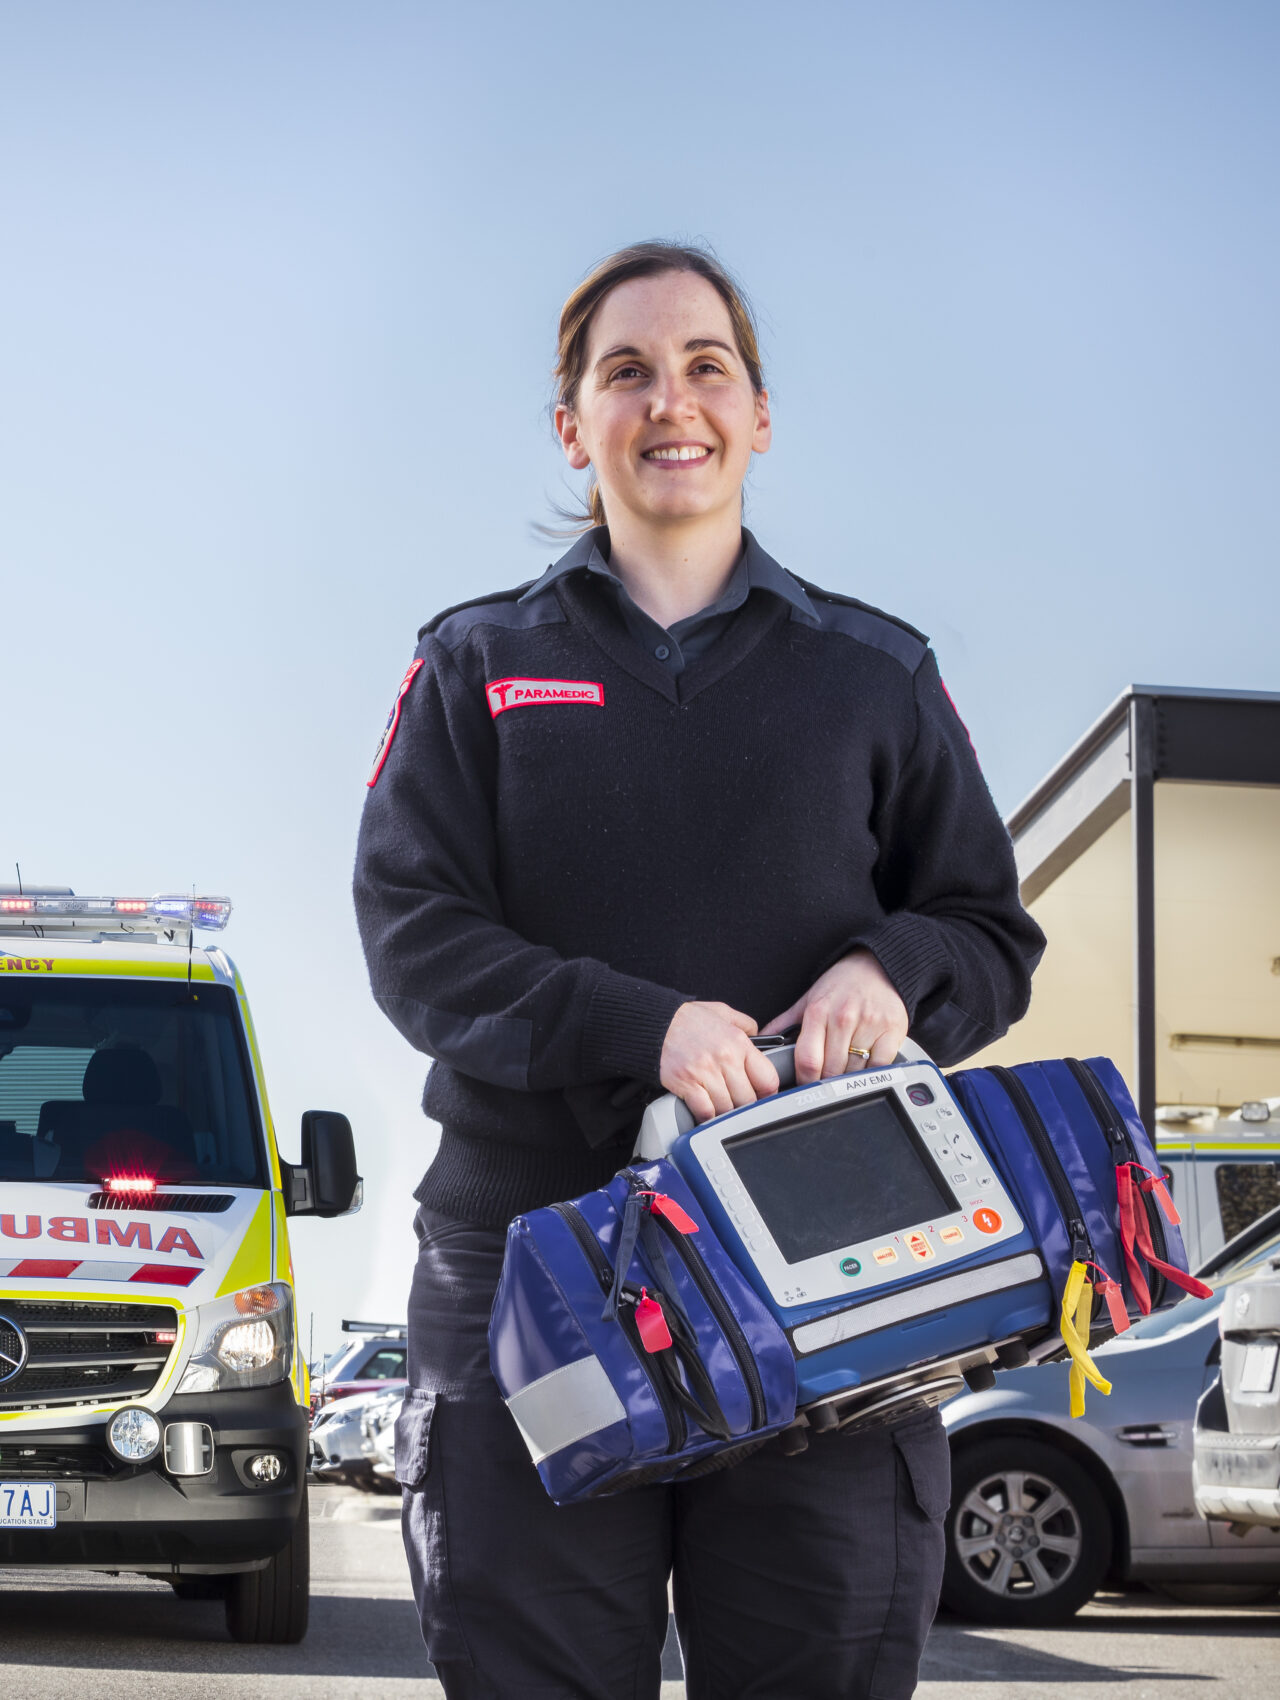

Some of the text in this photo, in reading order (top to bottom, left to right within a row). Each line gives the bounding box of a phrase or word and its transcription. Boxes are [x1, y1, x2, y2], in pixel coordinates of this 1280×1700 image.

[514, 688, 595, 700] PARAMEDIC
[846, 1073, 893, 1090] AAV EMU
[794, 1090, 828, 1106] ZOLL
[843, 1263, 858, 1271] PACER
[3, 1489, 50, 1517] 7AJ
